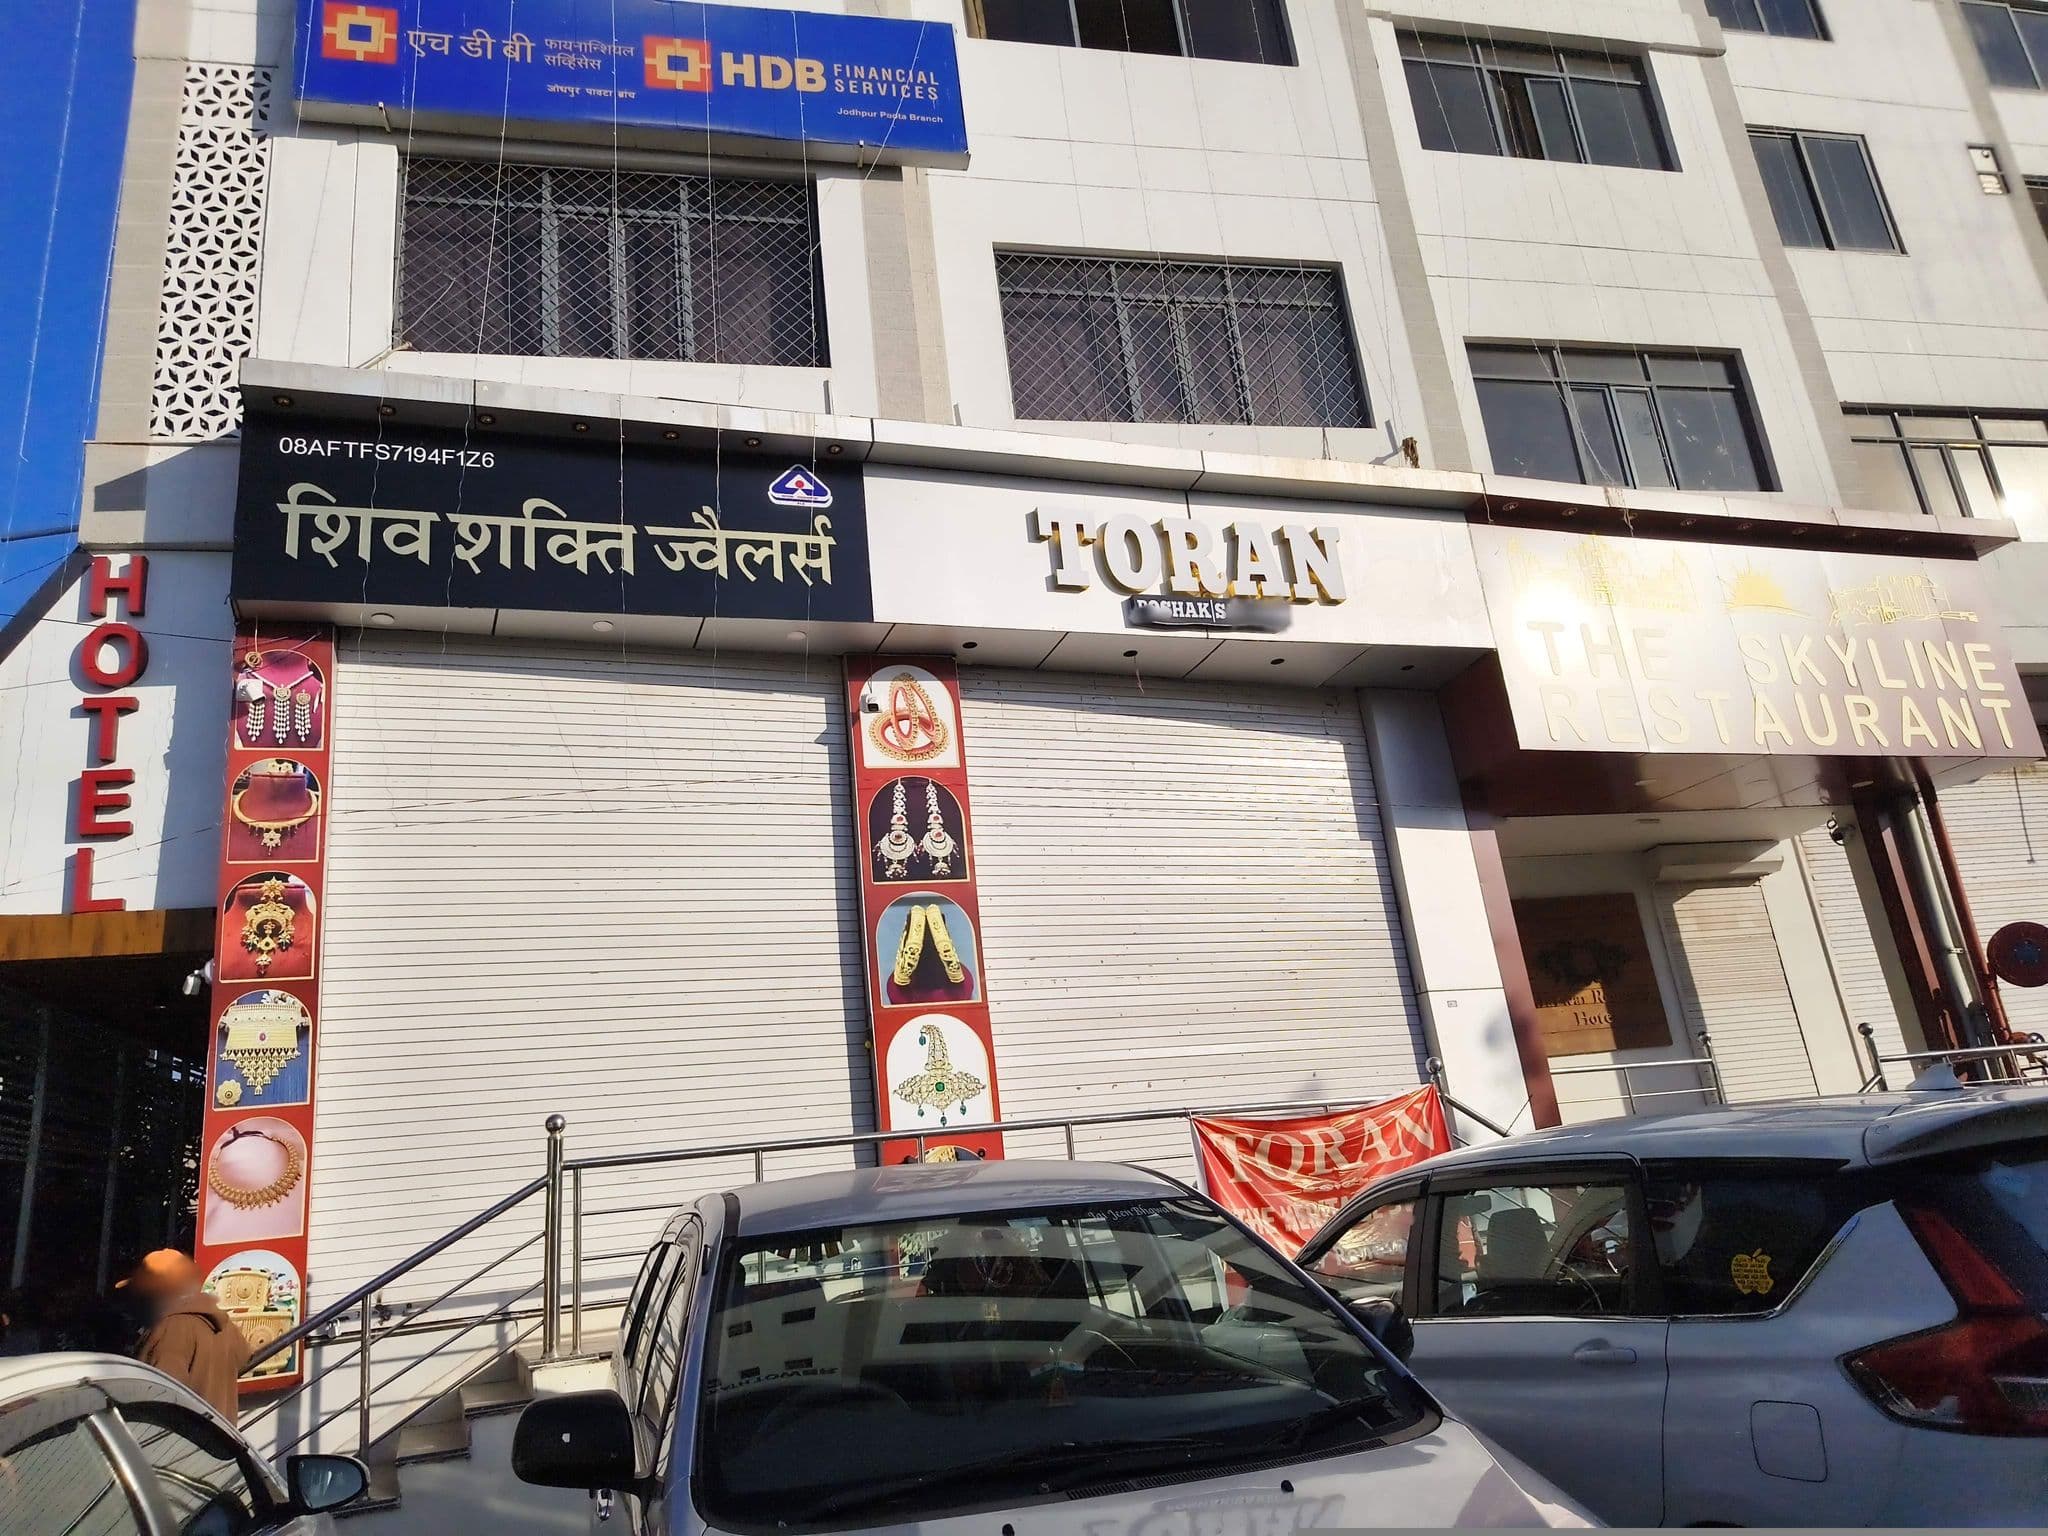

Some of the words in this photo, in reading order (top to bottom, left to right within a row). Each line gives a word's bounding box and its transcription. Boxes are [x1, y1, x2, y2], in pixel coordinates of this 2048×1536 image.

[407, 30, 453, 57] एच
[459, 28, 496, 60] डी
[502, 32, 536, 63] बी
[721, 52, 827, 93] HDB
[833, 63, 939, 86] FINANCIAL
[834, 79, 939, 101] SERVICES
[837, 107, 877, 118] Jodhpur
[909, 113, 943, 123] Branch
[279, 437, 495, 468] 08AFTFS7194F1Z6
[275, 482, 440, 570] शिव
[446, 497, 638, 577] शक्ति
[645, 506, 838, 587] ज्वैलर्स
[1027, 506, 1348, 606] TORAN
[1527, 621, 1681, 681] THE
[1738, 632, 2005, 692] SKYLINE
[73, 554, 149, 914] HOTEL
[1540, 685, 2012, 749] RESTAURANT
[1209, 1102, 1434, 1184] TORAN
